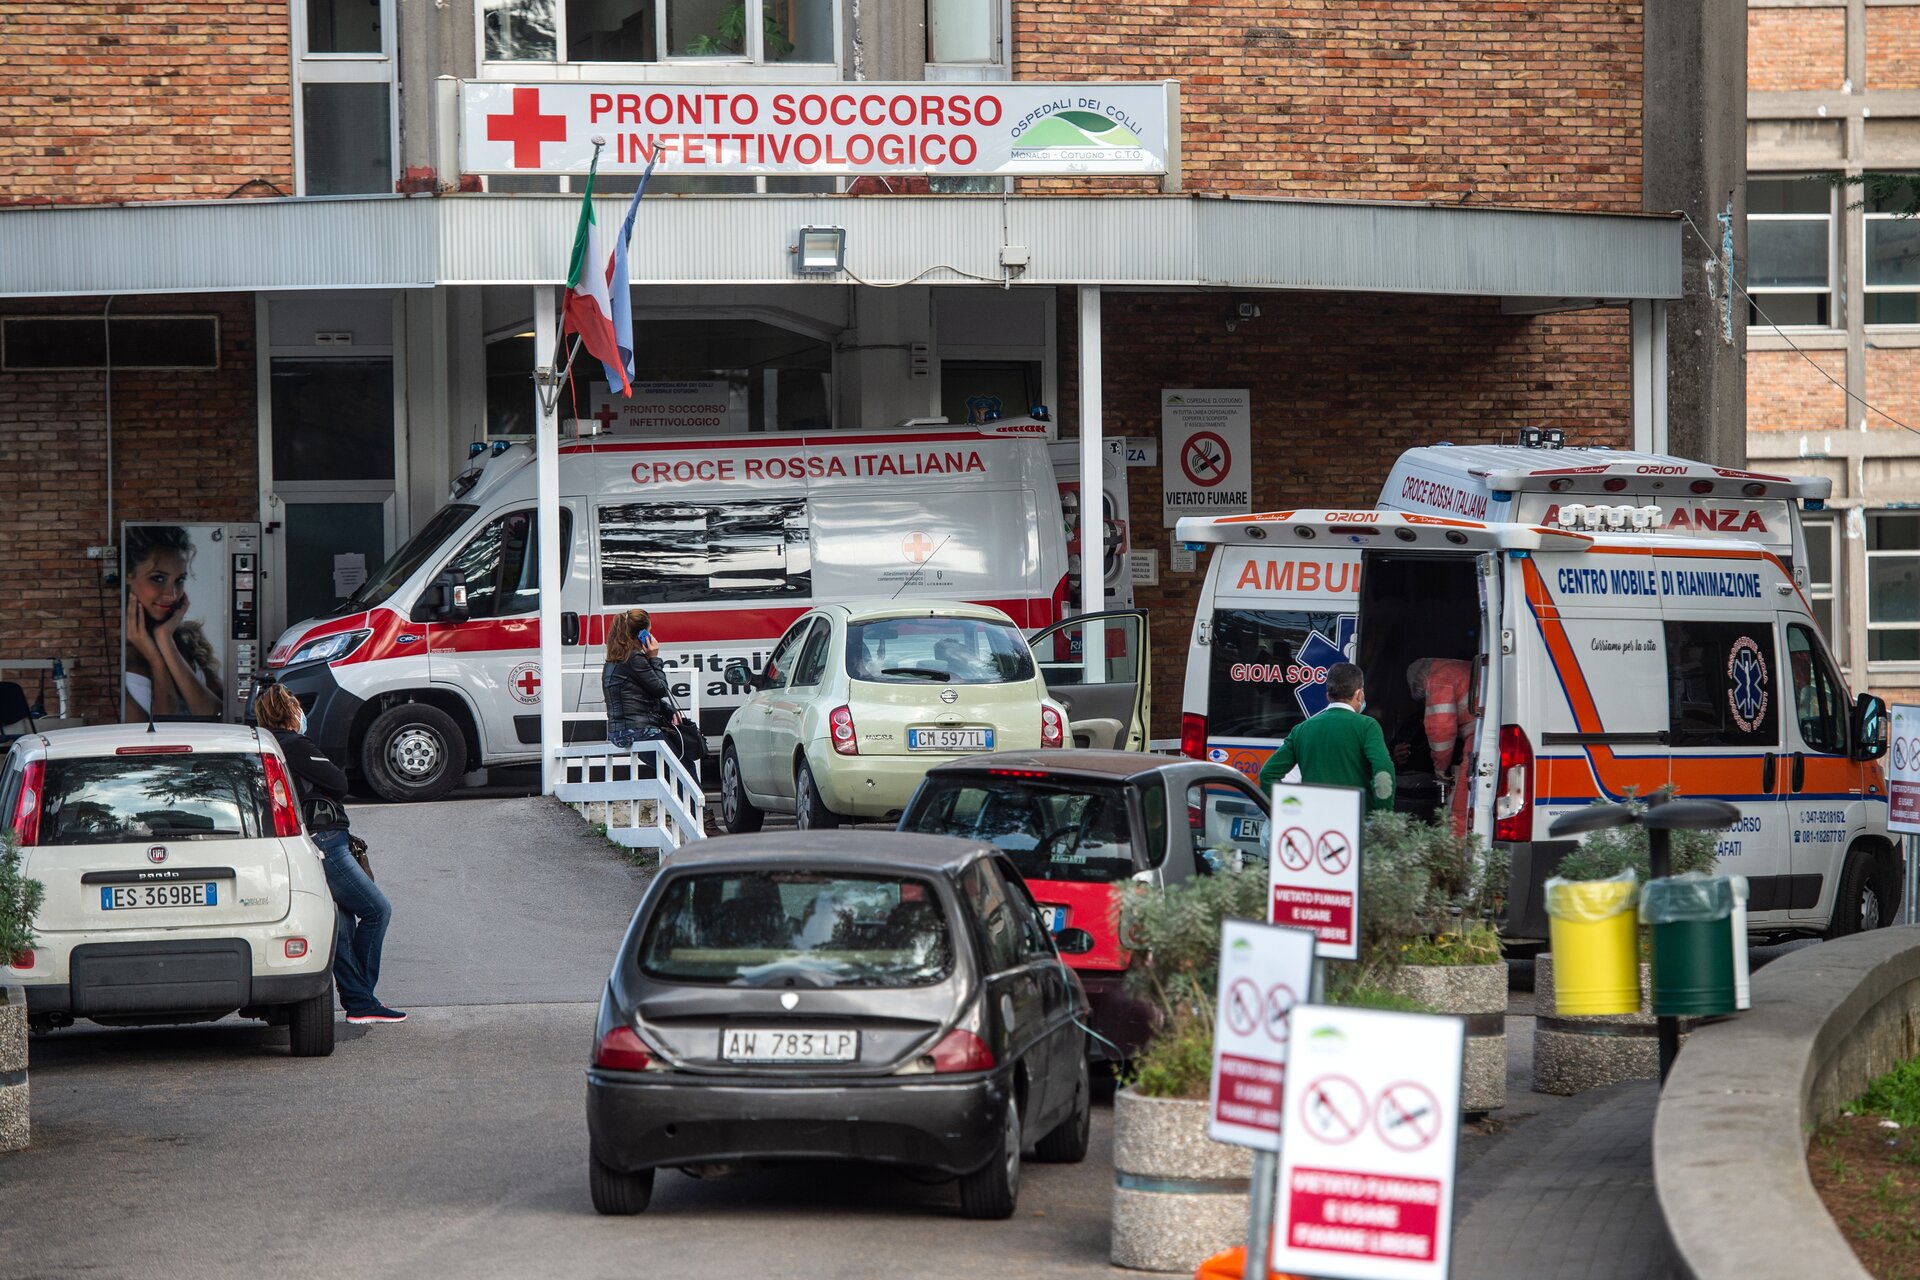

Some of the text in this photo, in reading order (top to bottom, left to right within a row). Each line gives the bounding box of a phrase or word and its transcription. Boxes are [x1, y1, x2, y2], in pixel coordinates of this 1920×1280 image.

[590, 93, 1002, 127] PRONTO SOCCORSO
[1011, 98, 1142, 138] OSPEDALI DEI COLLI
[616, 132, 978, 165] INFETTIVOLOGICO
[623, 404, 726, 414] PRONTO SOCCORSO
[629, 417, 720, 427] INFETTIVOLOGICO
[1126, 449, 1146, 461] ZA
[631, 451, 986, 485] CROCE ROSSA ITALIANA
[1636, 465, 1688, 475] ORION
[1166, 491, 1248, 505] VIETATO FUMARE
[1402, 475, 1488, 521] CROCE ROSSA ITALIANA
[1324, 512, 1379, 523] ORION
[1540, 504, 1768, 533] AANZA
[1558, 568, 1762, 598] CENTRO MOBILE DI RIANIMAZIONE
[1591, 637, 1656, 655] Corriamo per la vita
[1230, 663, 1284, 683] GIOIA
[918, 731, 936, 746] CM
[940, 731, 985, 746] 597TL
[1717, 816, 1762, 833] CORSO
[1805, 810, 1846, 824] 347-9218162
[1242, 820, 1259, 836] EN
[1802, 830, 1846, 843] 081-18267787
[152, 849, 164, 858] FIAT
[138, 871, 180, 880] panda
[114, 888, 138, 907] ES
[144, 885, 204, 906] 369BE
[1275, 889, 1352, 908] VIETATO FUMARE
[1292, 906, 1332, 922] E USARE
[729, 1033, 850, 1056] AW 783 LP
